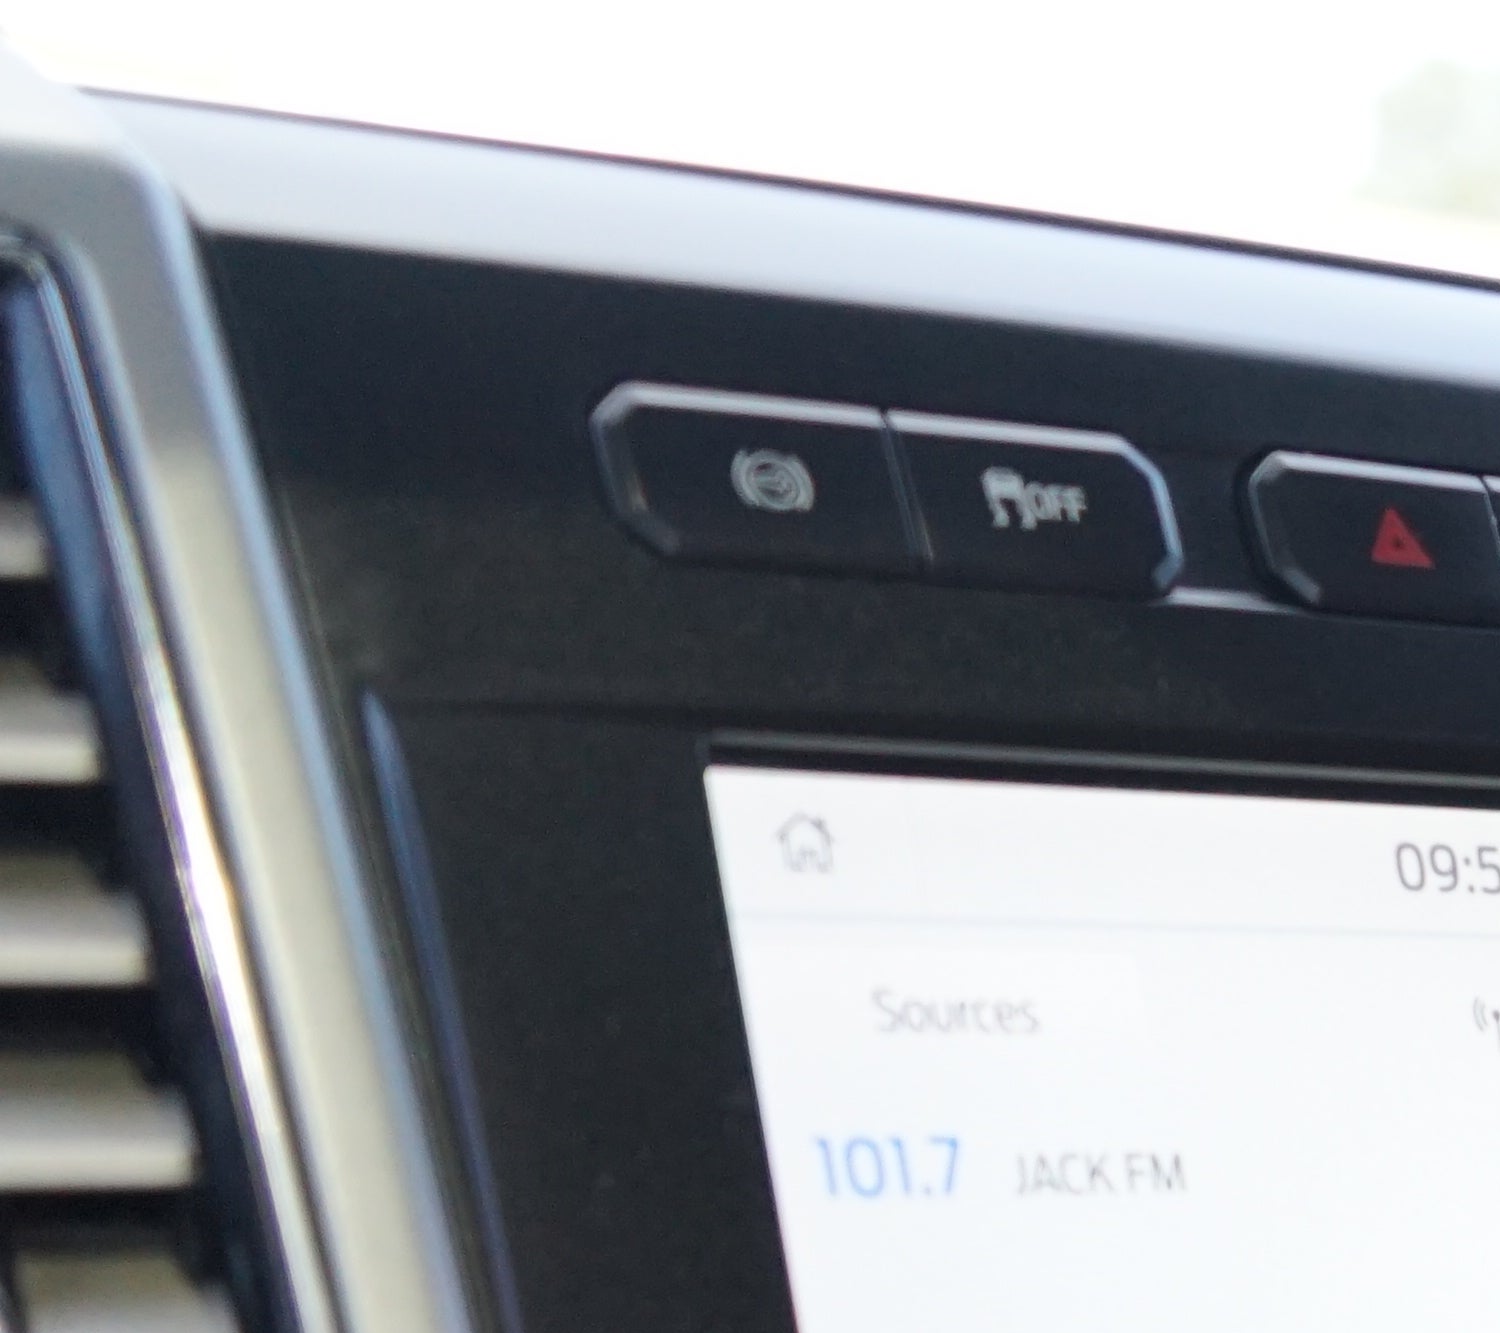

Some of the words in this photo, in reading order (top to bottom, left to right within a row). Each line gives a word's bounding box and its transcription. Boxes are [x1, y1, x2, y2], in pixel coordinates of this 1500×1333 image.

[1028, 482, 1087, 524] OFF
[870, 990, 1041, 1034] Sources
[814, 1135, 960, 1198] 101.7
[1014, 1152, 1116, 1196] JACK
[1126, 1154, 1187, 1192] FM
